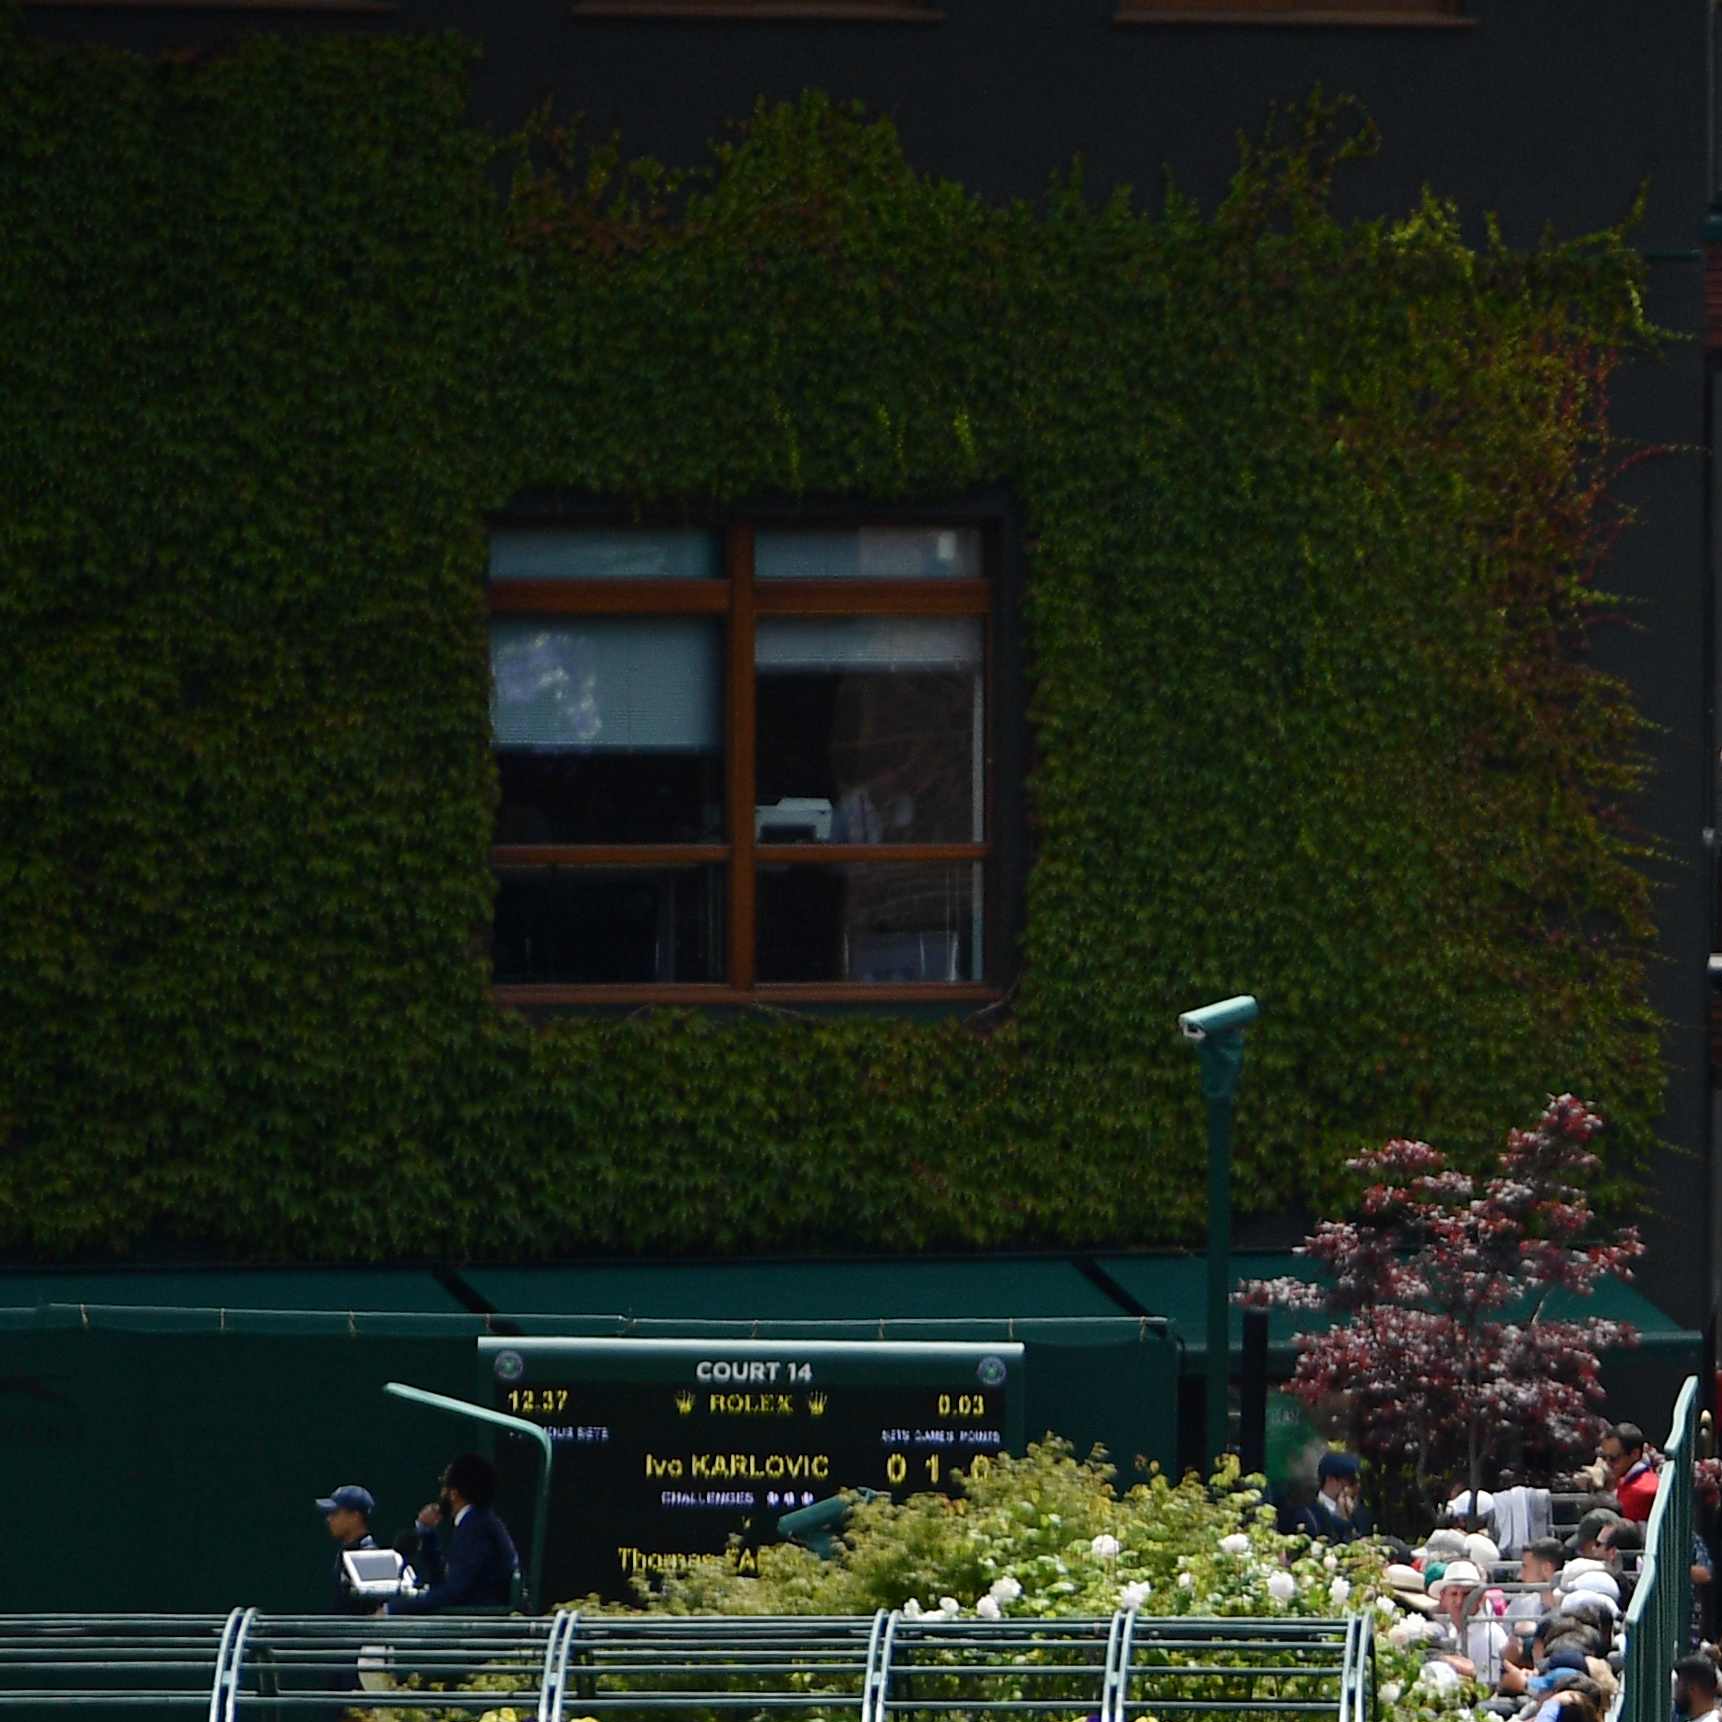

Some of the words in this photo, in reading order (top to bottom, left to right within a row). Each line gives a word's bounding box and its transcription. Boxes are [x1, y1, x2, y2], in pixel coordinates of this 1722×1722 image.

[696, 1361, 782, 1381] COURT
[787, 1362, 813, 1381] 14
[709, 1394, 793, 1415] ROLEX
[645, 1454, 683, 1478] Ivo
[691, 1454, 829, 1478] KARLOVIC
[887, 1453, 906, 1484] 0
[925, 1454, 939, 1483] 1
[661, 1491, 754, 1506] CHALLENGES
